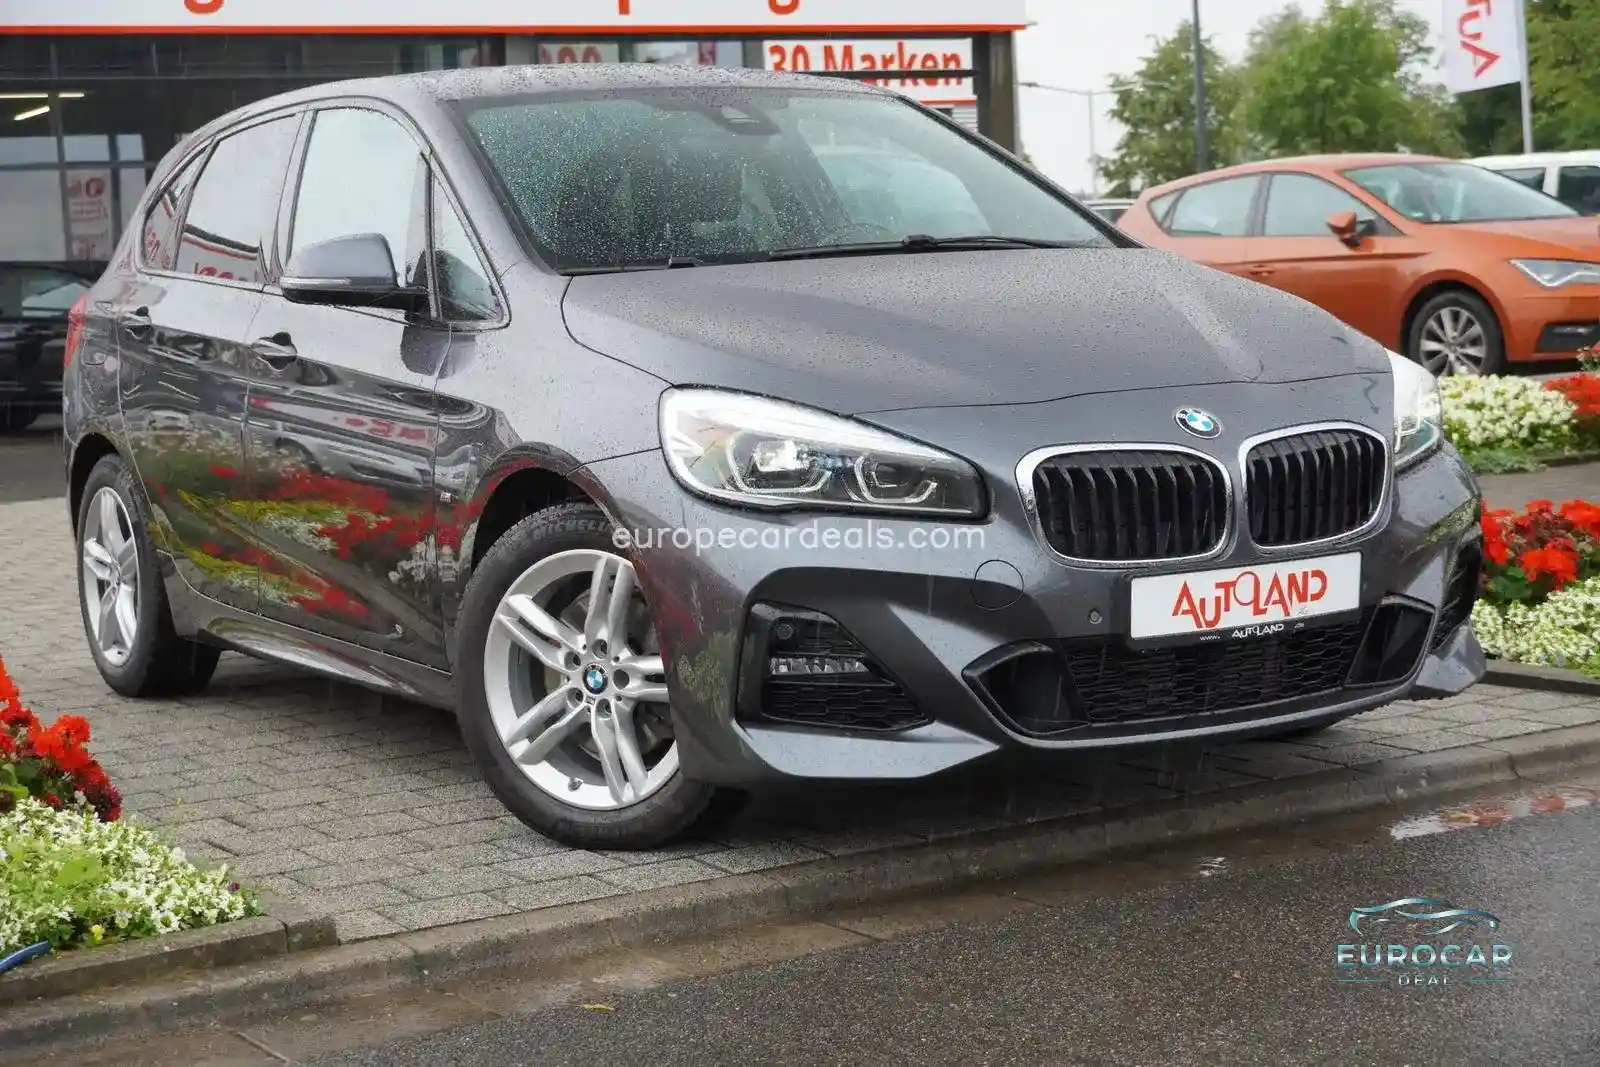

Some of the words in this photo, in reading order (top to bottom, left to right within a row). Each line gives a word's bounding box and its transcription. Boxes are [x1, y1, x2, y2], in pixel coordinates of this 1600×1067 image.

[823, 41, 963, 87] Marken
[1171, 569, 1328, 629] AUTOLAND
[1231, 623, 1285, 639] AUTOLAND
